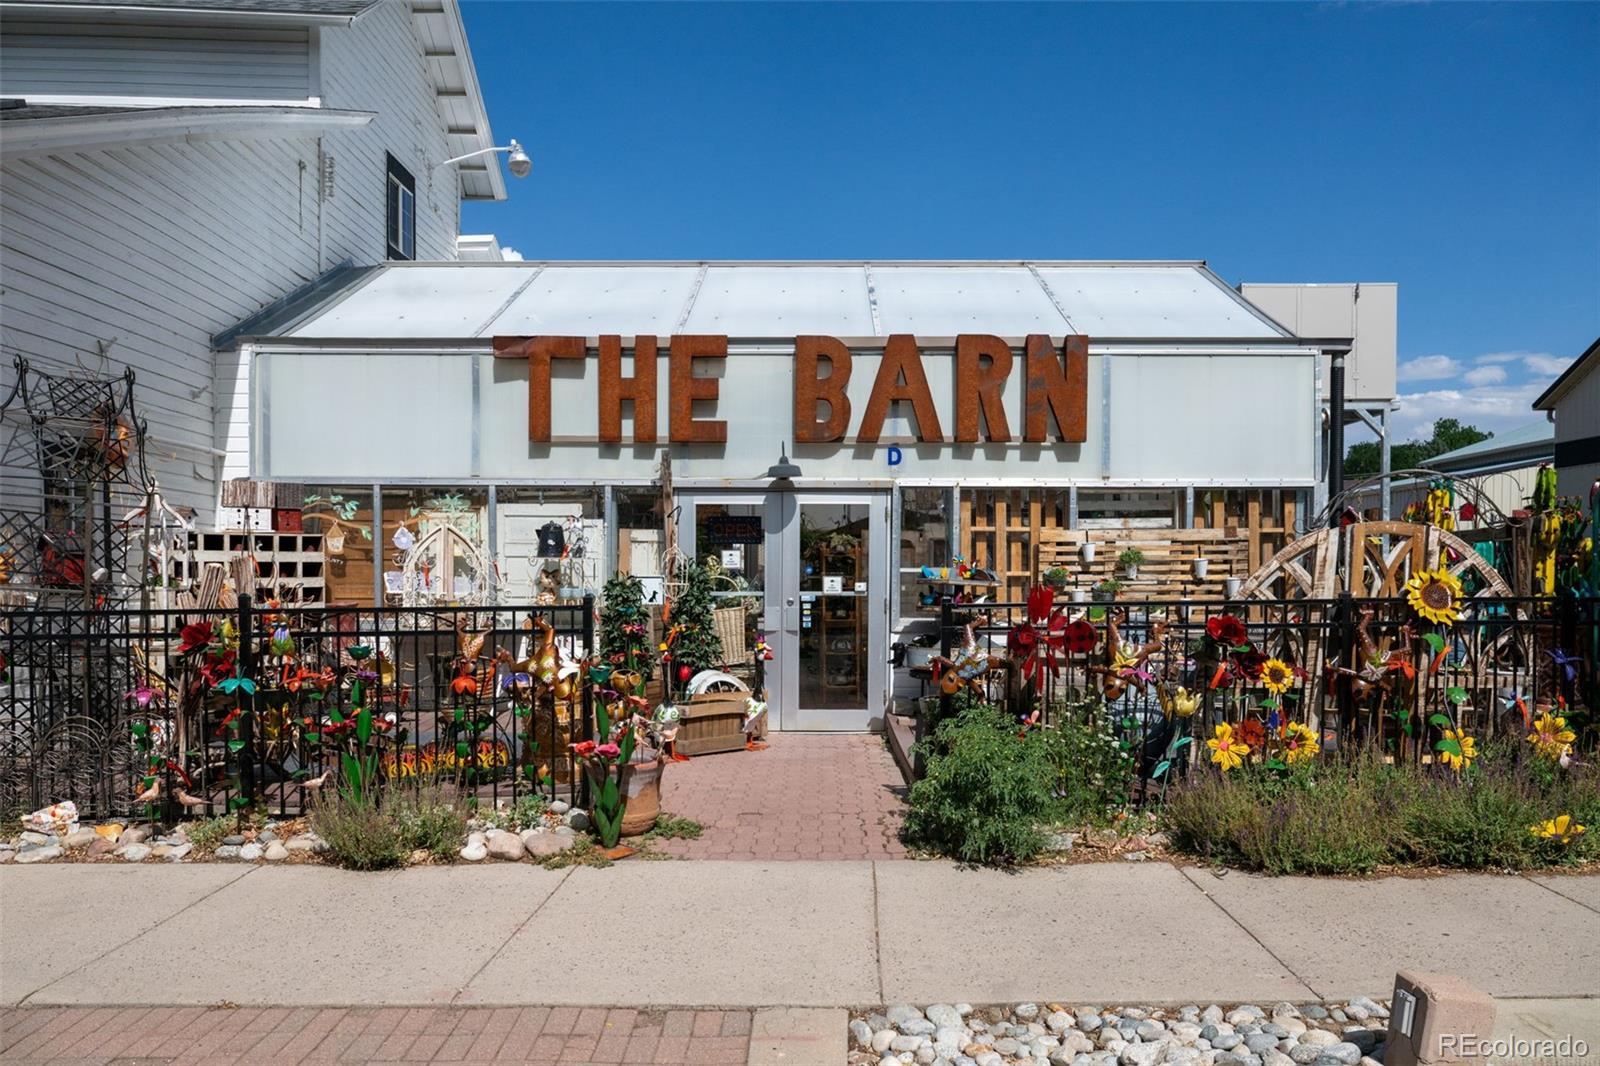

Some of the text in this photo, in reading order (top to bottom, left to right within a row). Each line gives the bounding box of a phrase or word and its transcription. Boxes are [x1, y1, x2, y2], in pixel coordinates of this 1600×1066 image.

[493, 333, 1089, 443] THE BARN
[887, 447, 903, 466] D
[712, 522, 759, 537] OPEN
